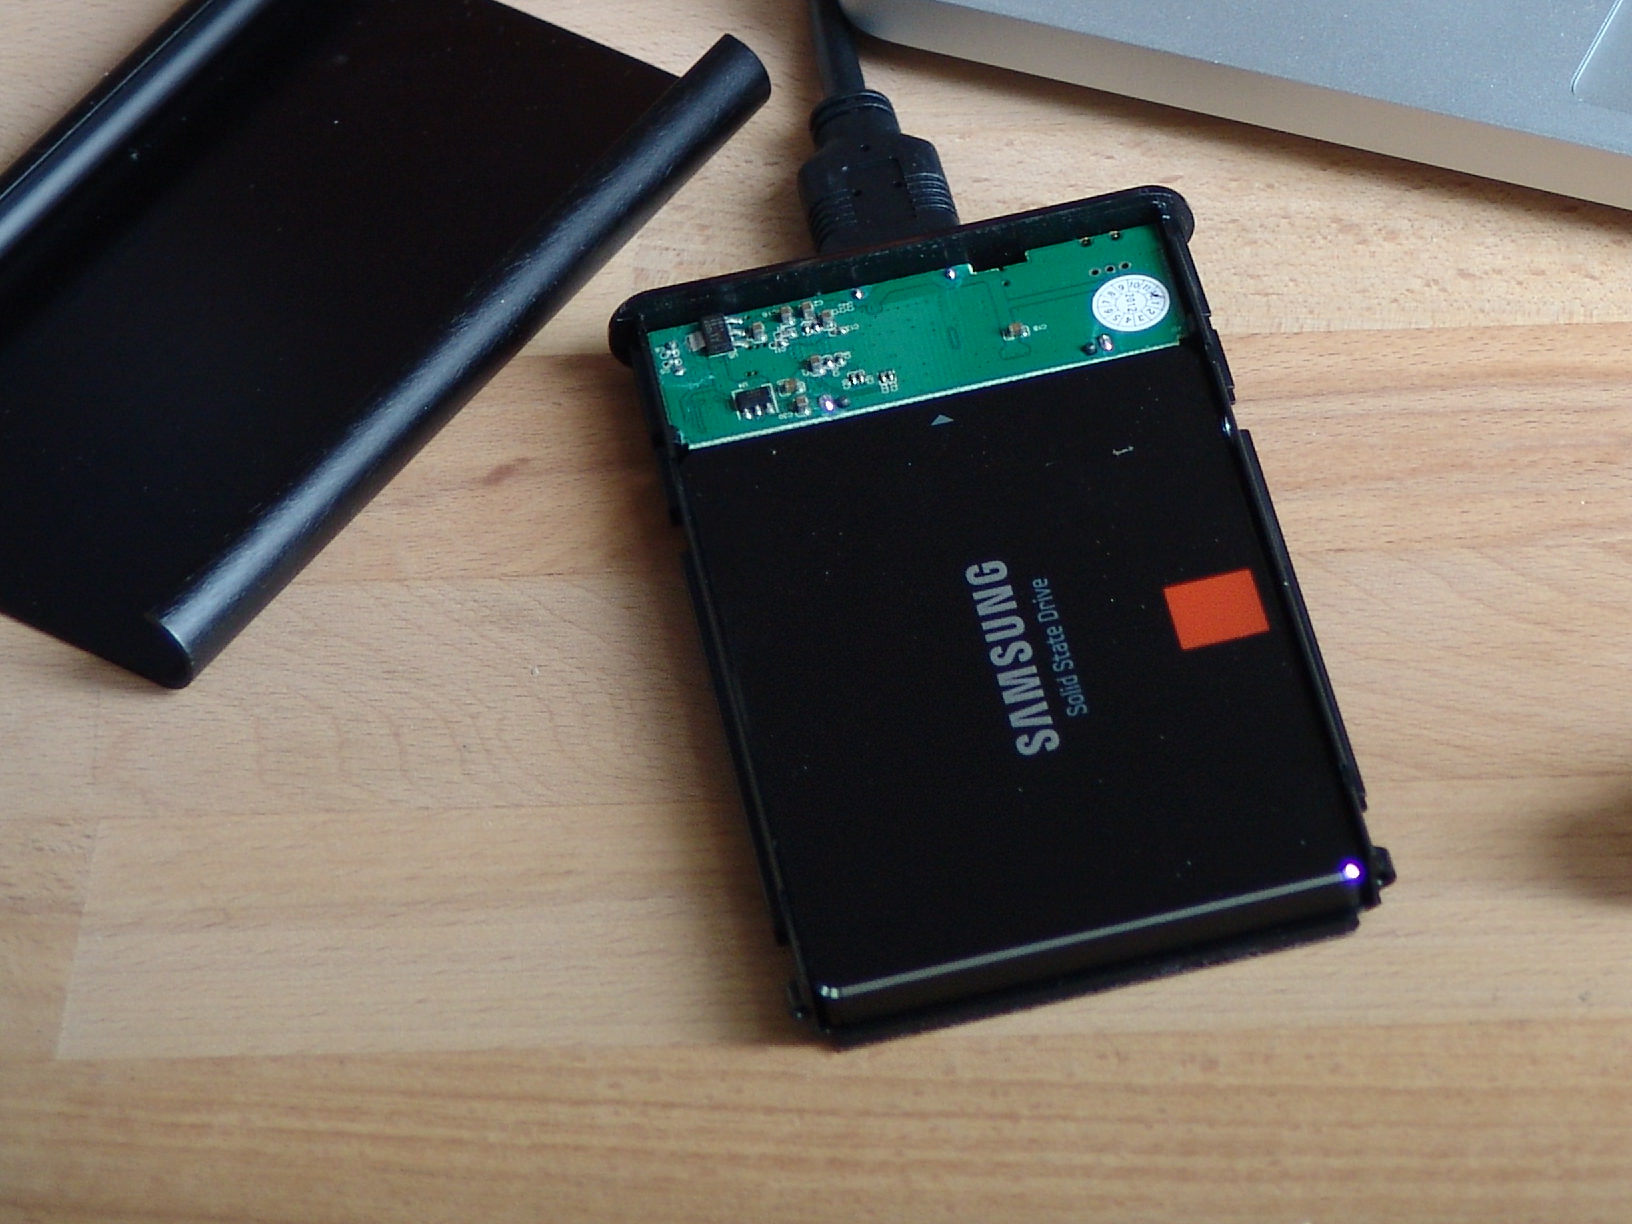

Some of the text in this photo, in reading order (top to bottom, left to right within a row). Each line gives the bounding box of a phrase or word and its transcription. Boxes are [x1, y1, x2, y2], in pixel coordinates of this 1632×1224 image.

[965, 560, 1060, 756] SAMSUNG
[1032, 578, 1088, 717] Solid State Drive
